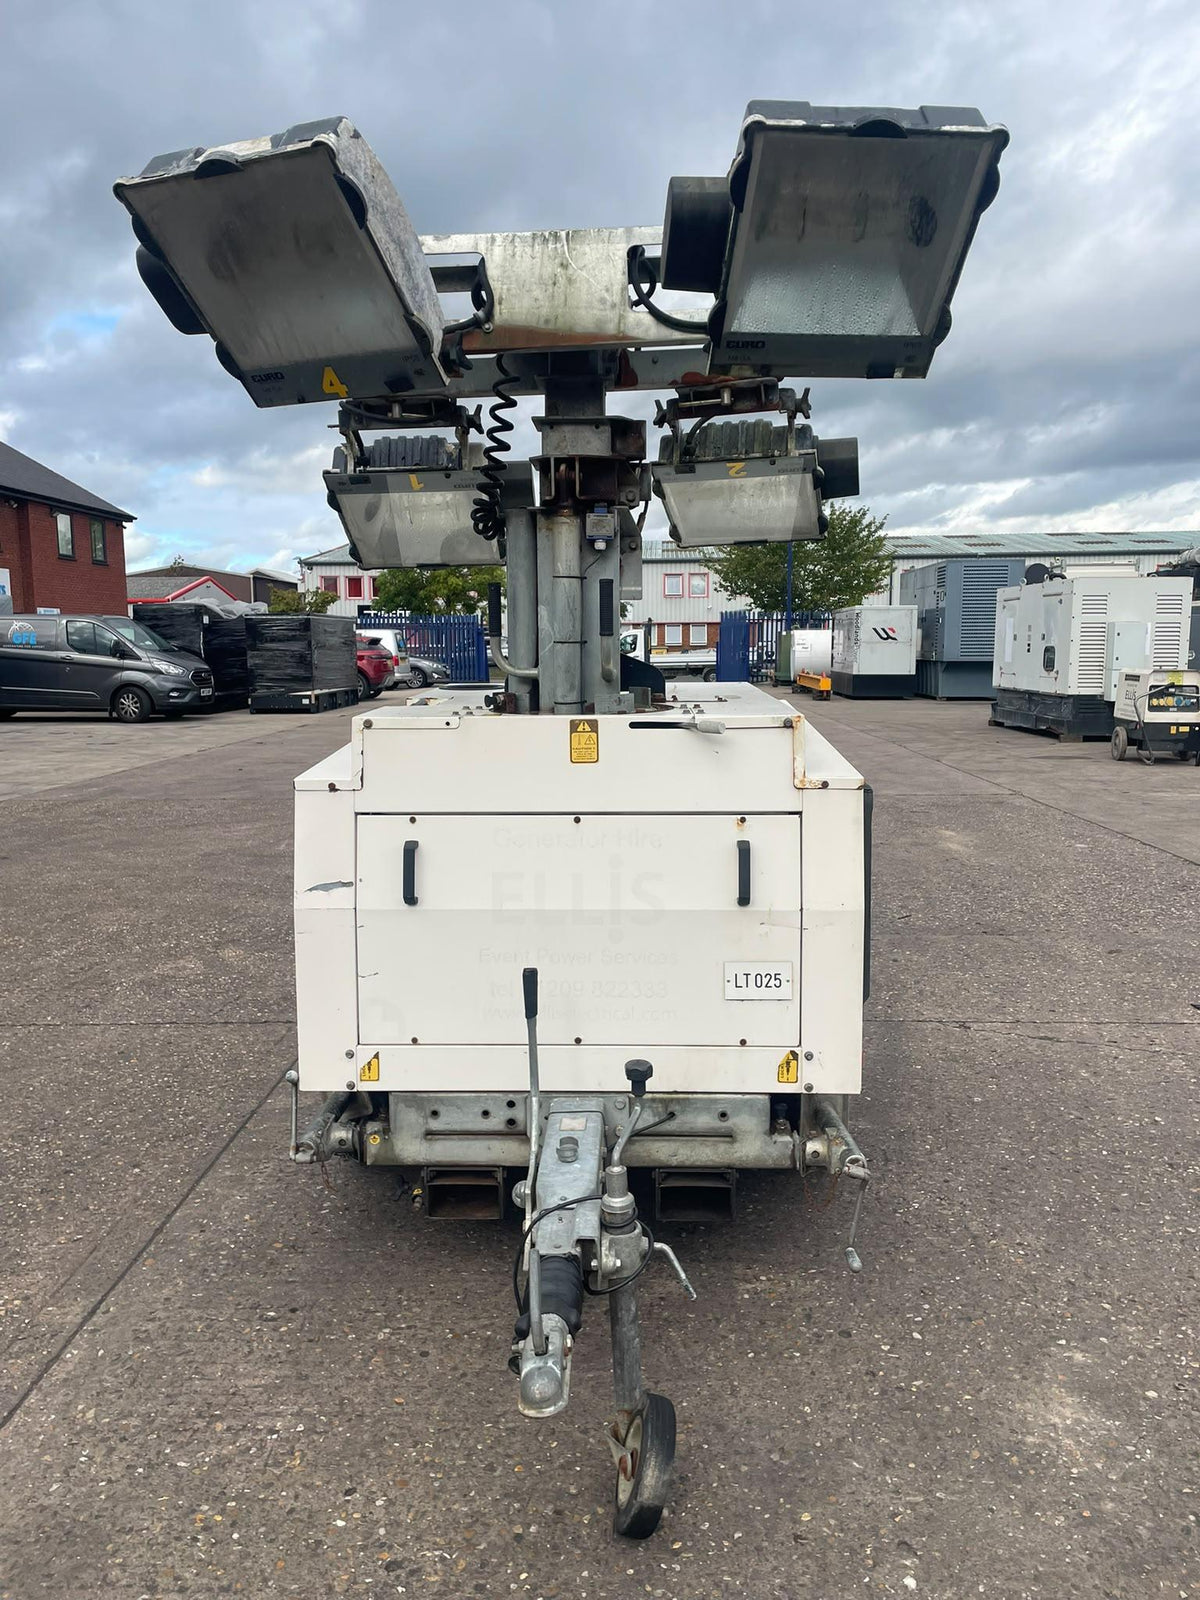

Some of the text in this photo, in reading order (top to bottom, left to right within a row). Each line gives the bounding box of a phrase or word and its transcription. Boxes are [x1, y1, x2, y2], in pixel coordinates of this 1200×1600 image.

[726, 340, 766, 349] EURO
[251, 371, 286, 382] EURO
[322, 365, 349, 398] 4
[726, 462, 747, 478] 2
[408, 474, 424, 491] 1
[12, 631, 37, 645] GFE
[492, 826, 607, 849] Generator
[478, 947, 679, 966] Event Power Services
[734, 973, 782, 988] LT 025
